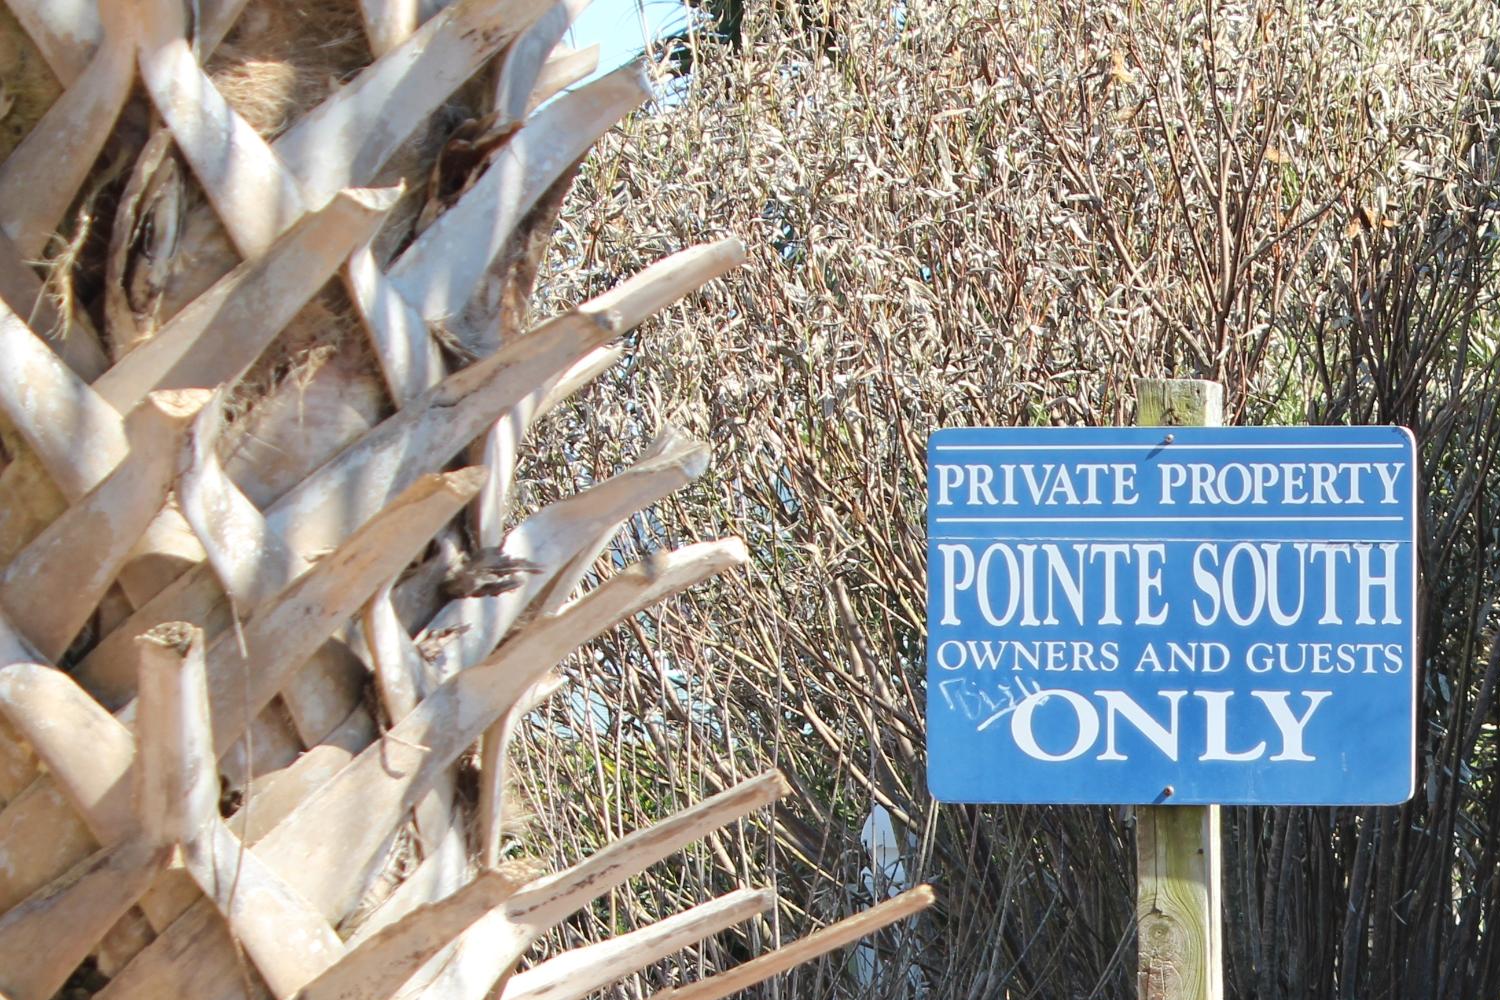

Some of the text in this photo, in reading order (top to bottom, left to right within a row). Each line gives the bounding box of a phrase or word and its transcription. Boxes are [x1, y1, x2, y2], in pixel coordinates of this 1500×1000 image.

[934, 462, 1405, 505] PRIVATE PROPERTY
[937, 542, 1403, 627] POINTE SOUTH
[936, 640, 1404, 674] OWNERS AND GUESTS
[1010, 689, 1333, 762] ONLY
